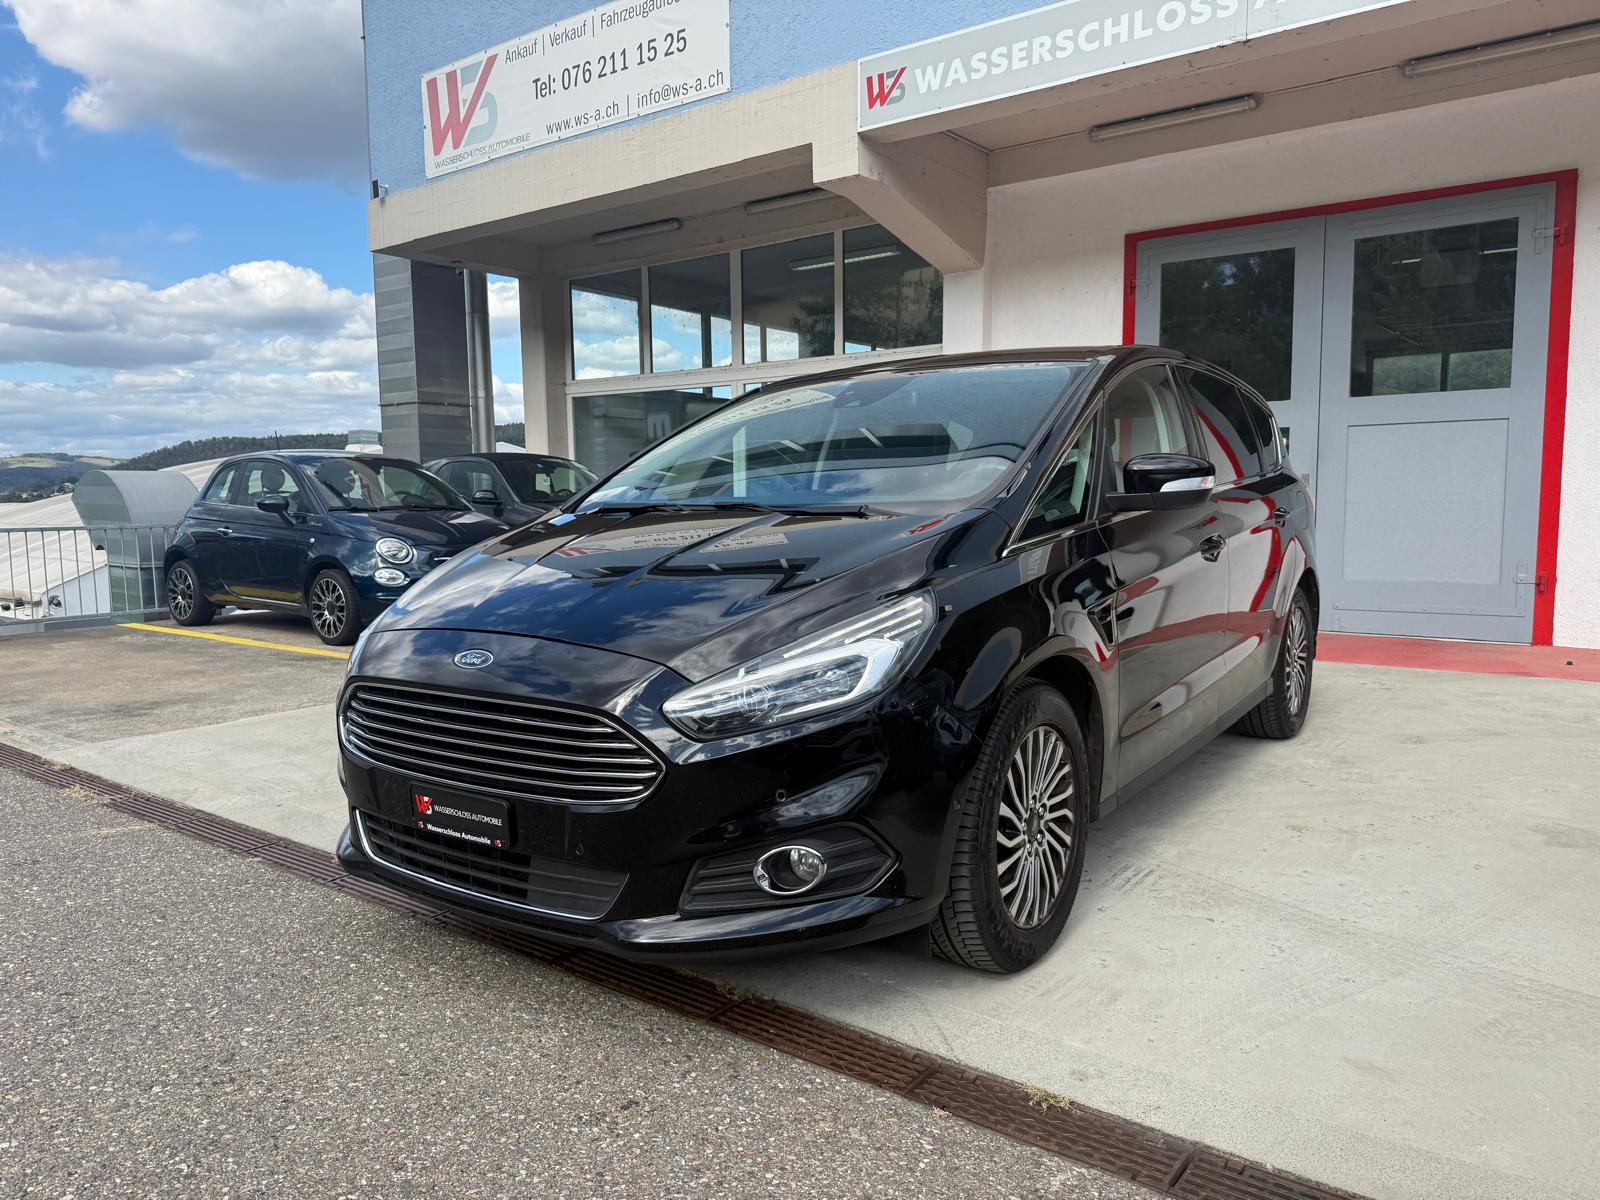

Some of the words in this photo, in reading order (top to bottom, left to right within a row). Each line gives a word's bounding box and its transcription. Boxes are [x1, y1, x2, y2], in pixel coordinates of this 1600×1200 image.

[504, 38, 538, 64] Ankauf
[549, 20, 587, 47] Verkauf
[914, 0, 1239, 94] WASSERSCHLOSS
[532, 74, 556, 100] Tel:
[561, 60, 592, 91] 076
[597, 48, 628, 78] 211
[637, 38, 657, 66] 15
[663, 28, 687, 57] 25
[546, 101, 619, 135] www.ws-a.ch
[637, 69, 724, 109] info@ws-a.ch
[434, 145, 487, 169] WASSERSCHLOSS
[488, 132, 531, 152] AUTOMOBILE
[461, 652, 486, 665] Ford
[426, 823, 461, 838] Wasserschloss
[461, 832, 491, 845] Automobile
[433, 804, 472, 820] WASSERSCHLOSS
[471, 813, 503, 827] AUTOMOBILE
